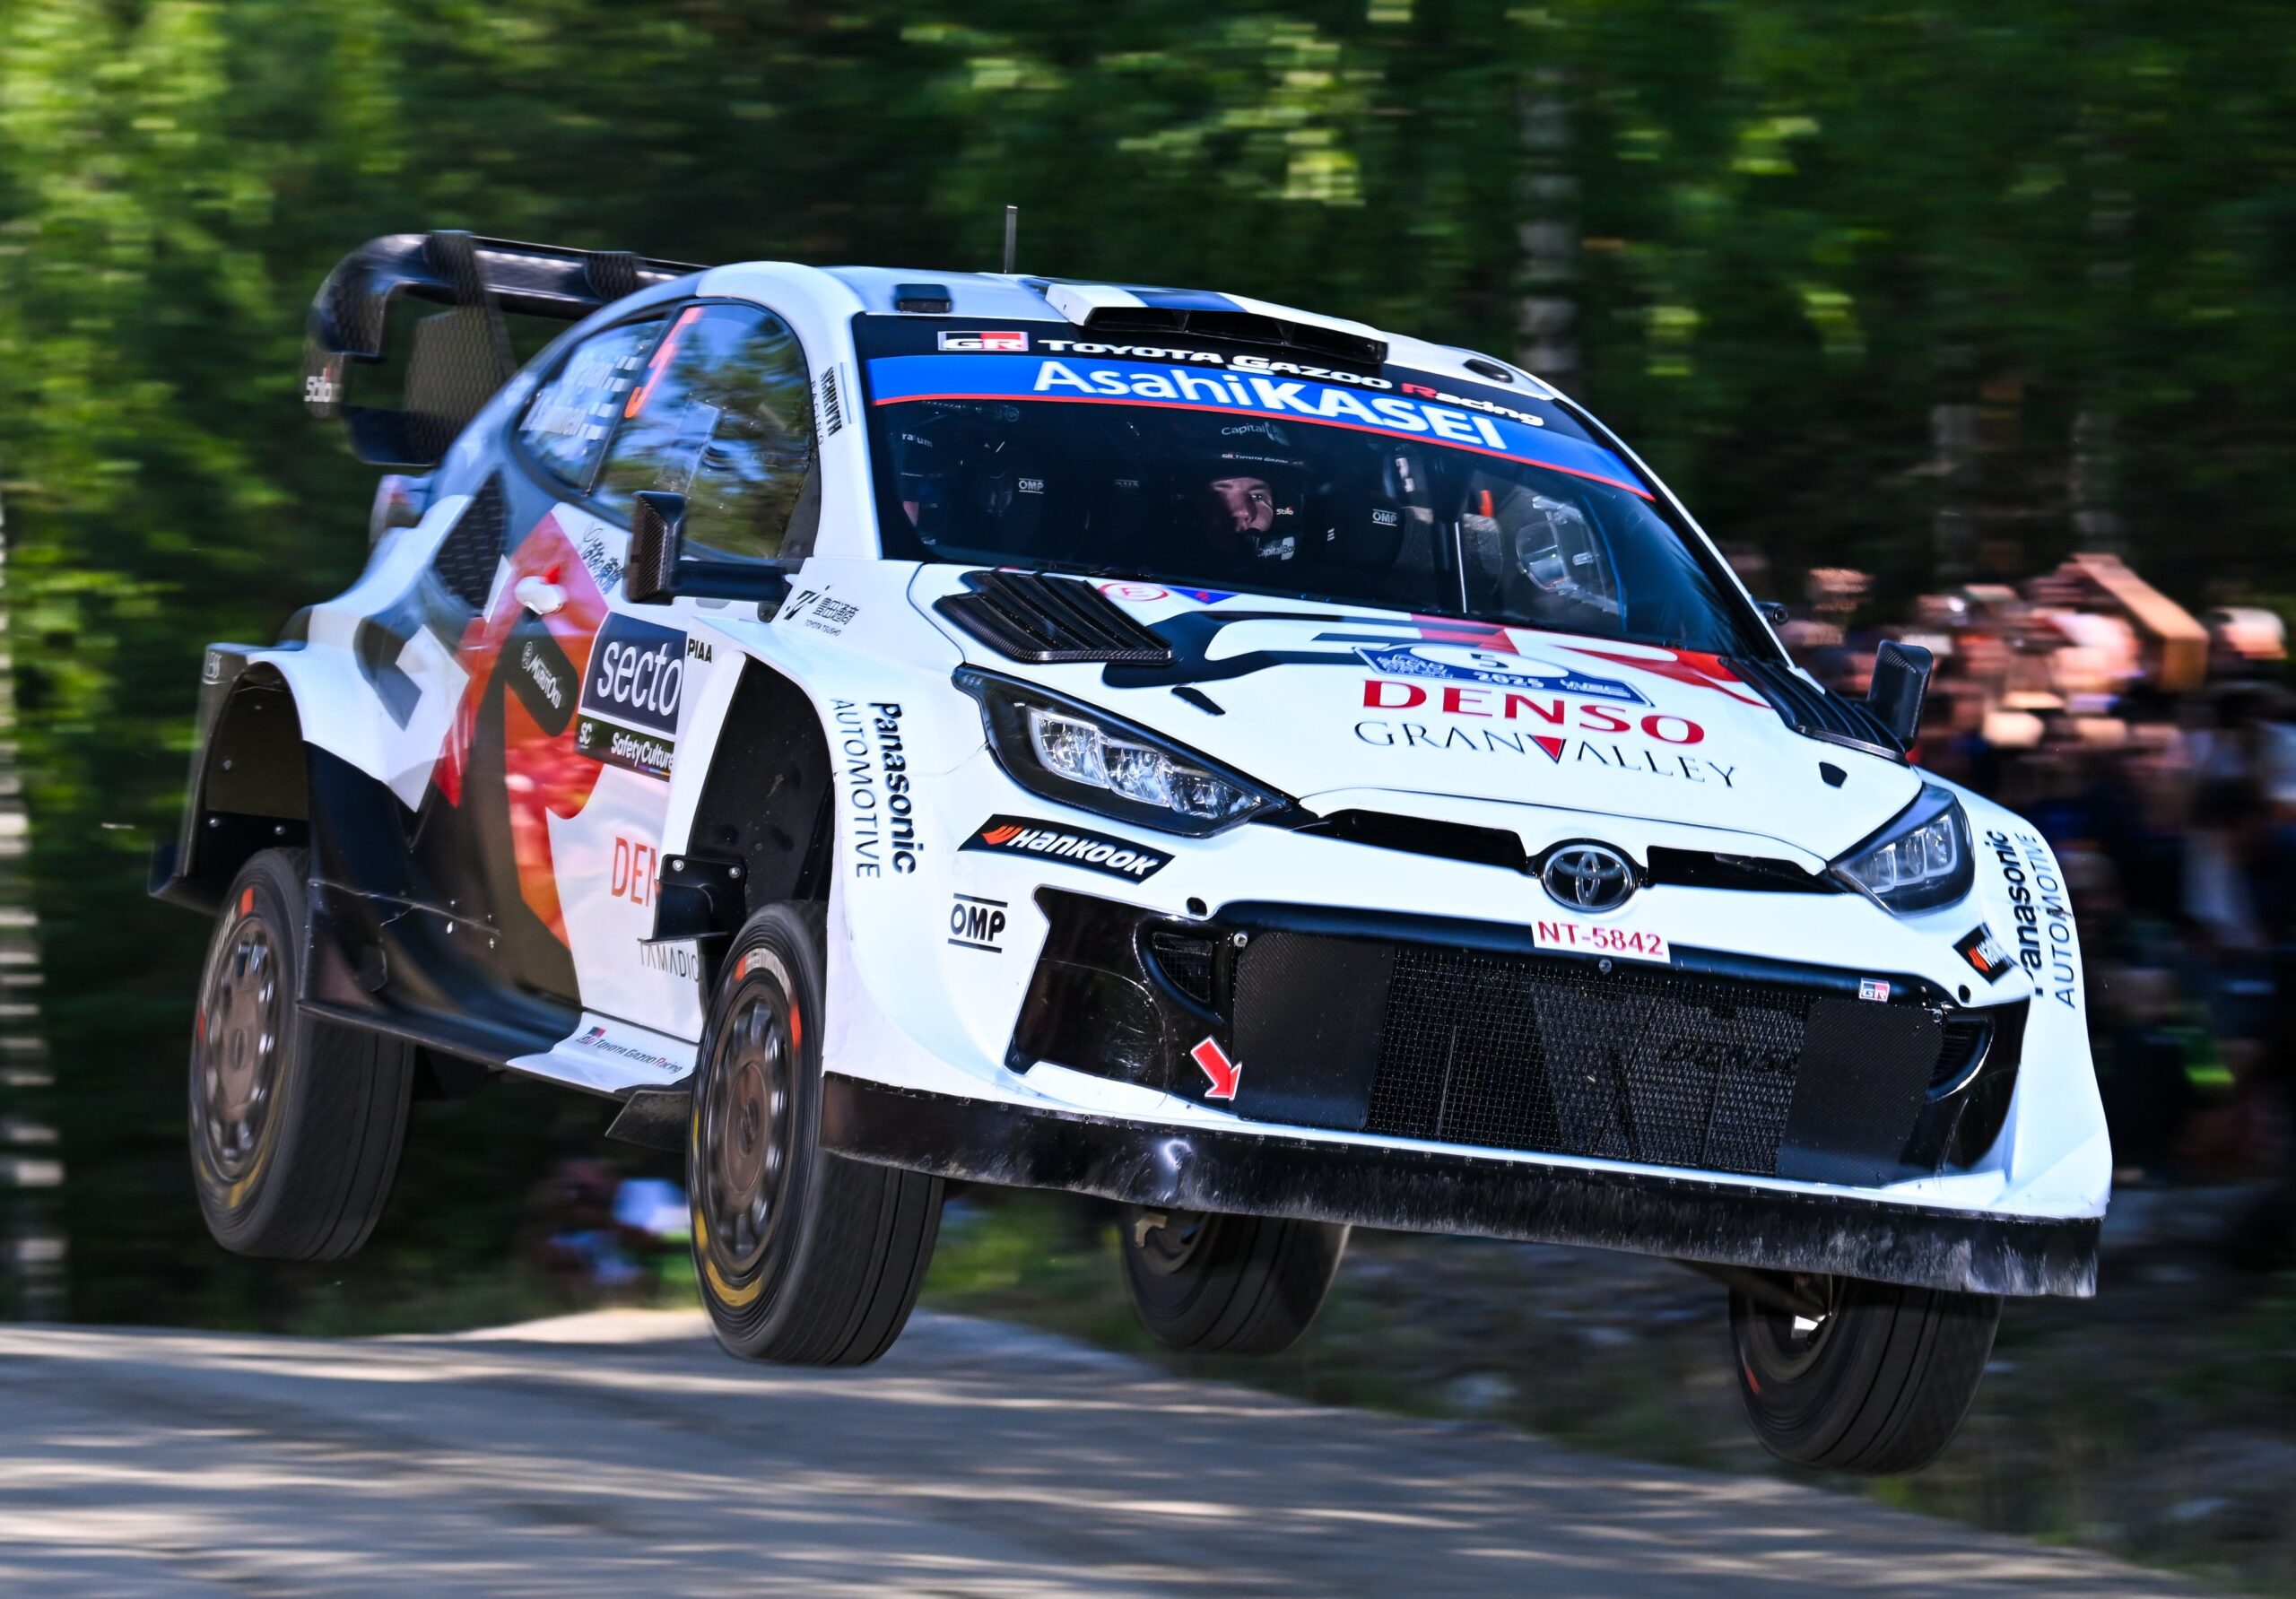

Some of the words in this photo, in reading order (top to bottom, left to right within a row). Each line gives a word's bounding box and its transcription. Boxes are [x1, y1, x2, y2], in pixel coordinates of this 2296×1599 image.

[943, 337, 1024, 351] GR
[1038, 339, 1224, 365] TOYOTA
[1228, 355, 1393, 389] GAZOO
[1401, 383, 1544, 427] Racing
[1018, 479, 1045, 491] OMP
[1372, 510, 1397, 525] OMP
[686, 638, 713, 664] PIAA
[596, 641, 683, 717] secto
[1473, 671, 1544, 689] 2025
[1363, 679, 1705, 745] DENSO
[830, 697, 881, 879] AUTOMOTIVE
[867, 701, 926, 875] Panasonic
[611, 836, 660, 908] DEN
[949, 902, 1006, 943] OMP
[1537, 919, 1665, 957] NT-5842
[2014, 831, 2076, 1010] AUTOMOTIVE
[593, 1038, 627, 1056] TOYOTA
[623, 1048, 657, 1065] GAZOO
[654, 1056, 683, 1074] Racing
